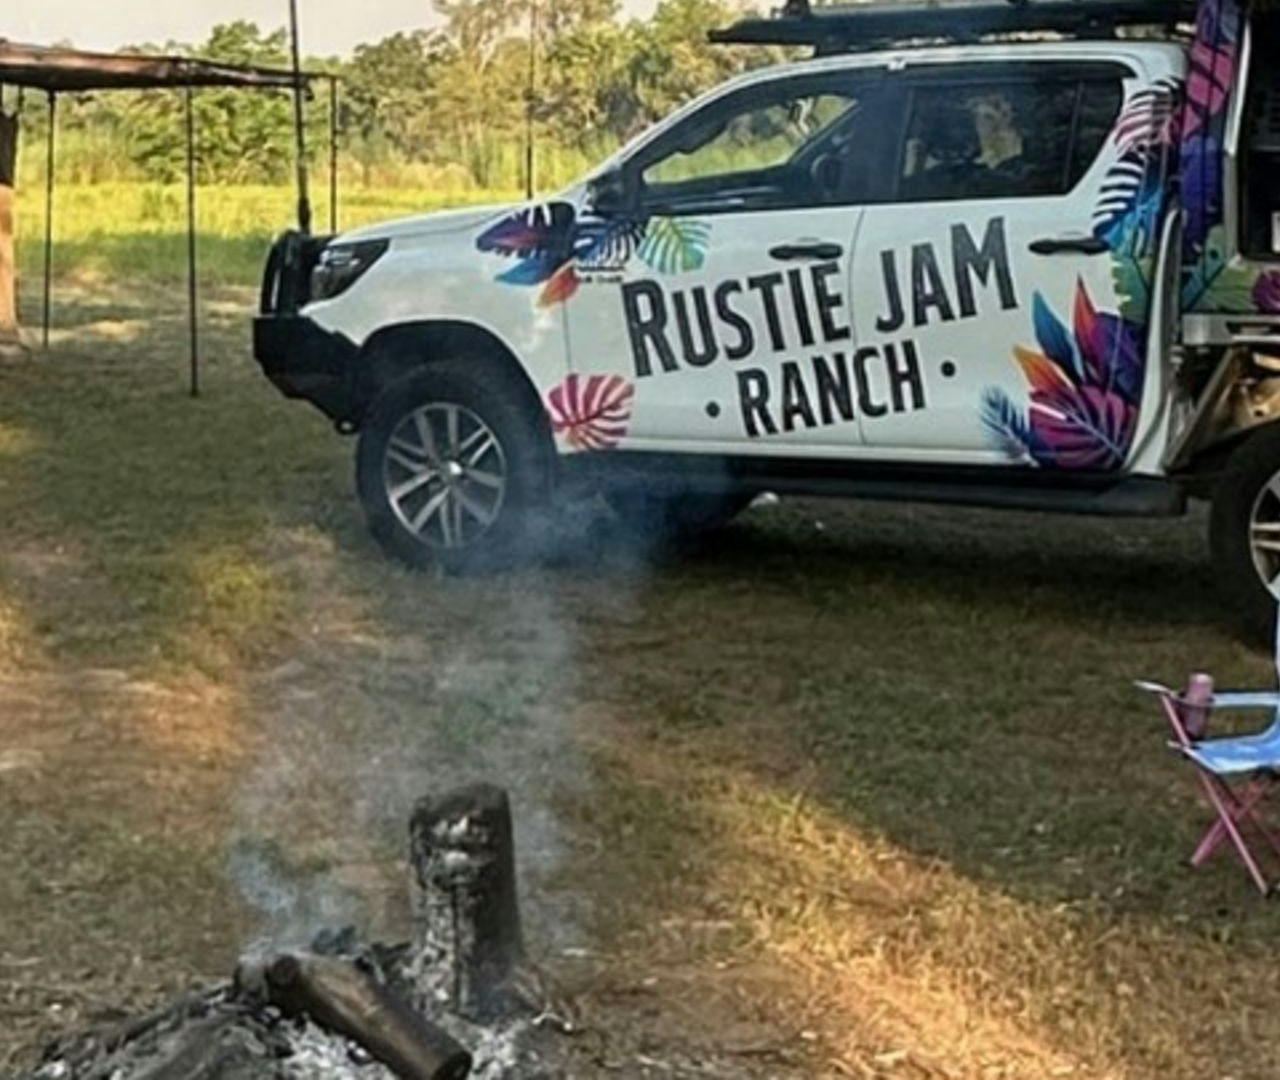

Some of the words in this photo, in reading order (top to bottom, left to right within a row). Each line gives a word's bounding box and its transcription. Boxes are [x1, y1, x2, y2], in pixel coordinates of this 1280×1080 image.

[621, 262, 851, 378] RUSTIE
[876, 216, 1019, 333] JAM
[736, 339, 926, 438] RANCH
